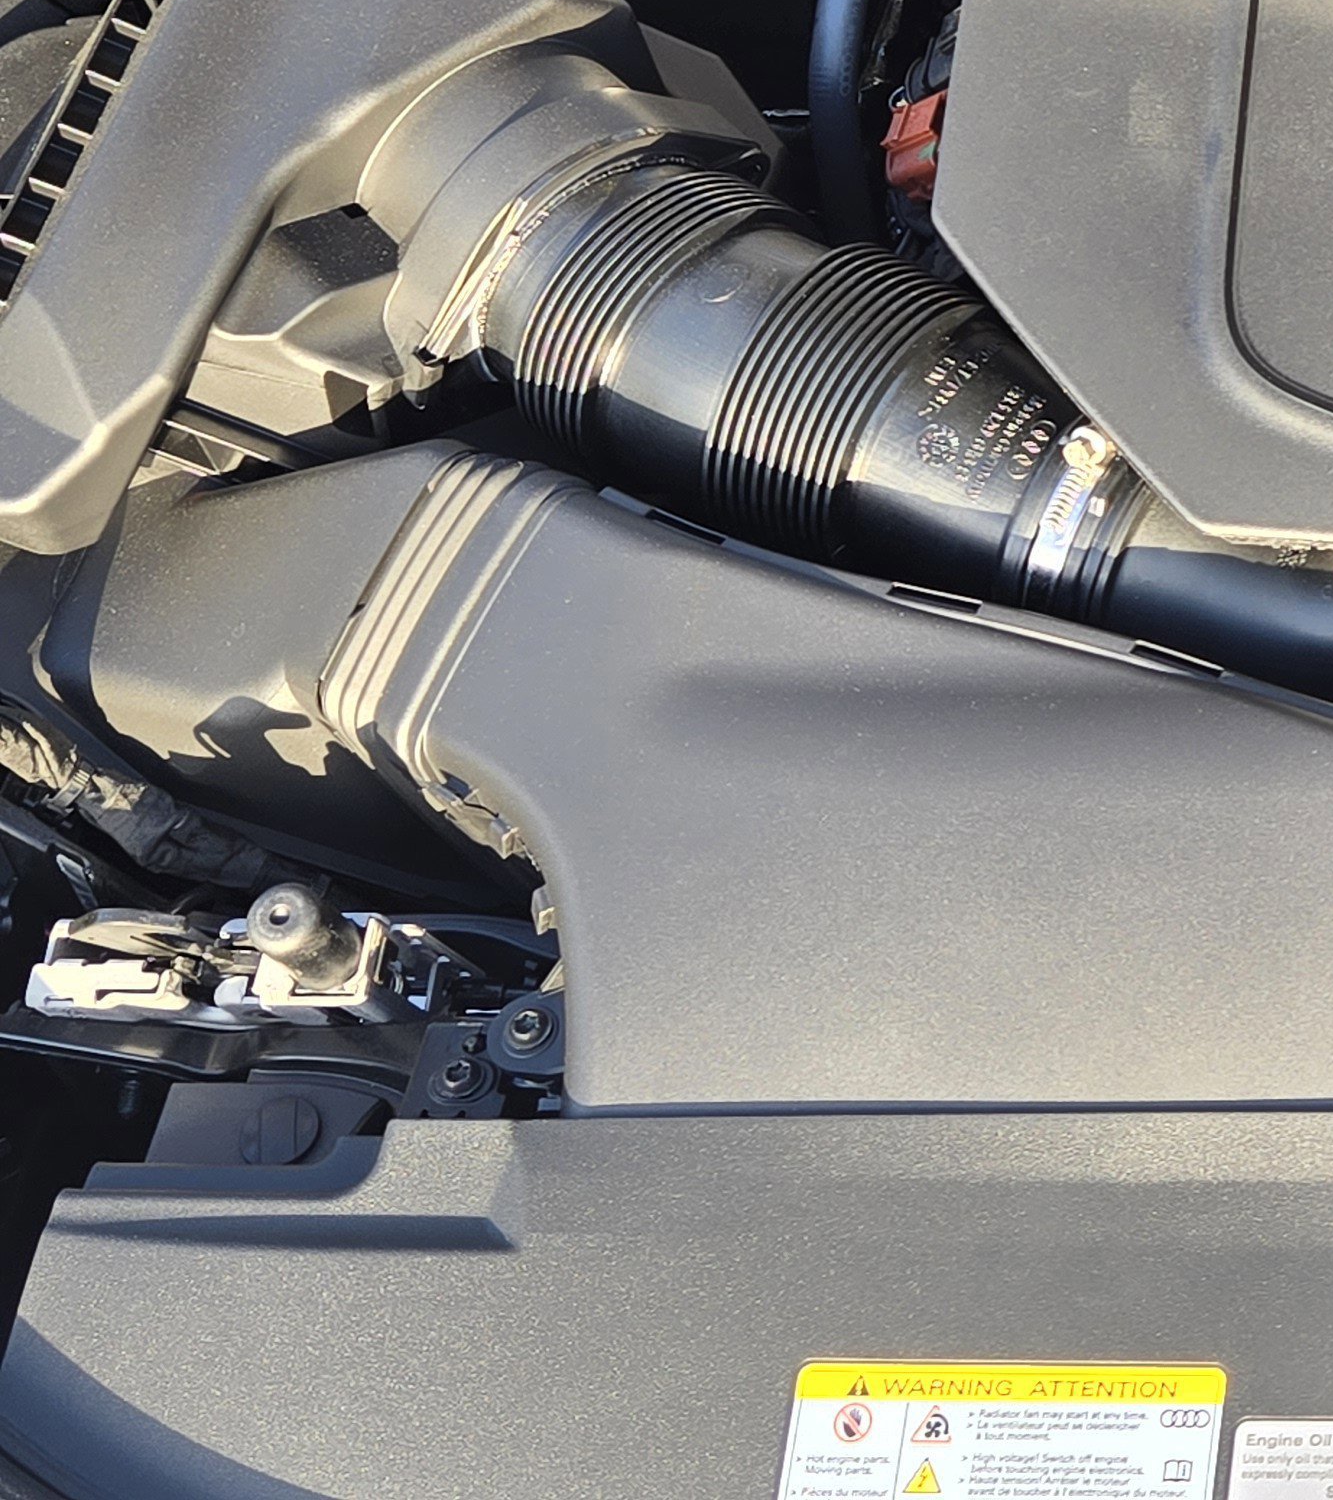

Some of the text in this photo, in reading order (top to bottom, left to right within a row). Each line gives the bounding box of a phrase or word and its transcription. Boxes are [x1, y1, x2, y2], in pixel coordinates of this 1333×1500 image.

[884, 1378, 1178, 1399] WARNING ATTENTION
[1246, 1433, 1332, 1450] Engine Oil
[1243, 1453, 1264, 1464] Use
[1267, 1453, 1293, 1466] only
[1295, 1453, 1310, 1464] oil
